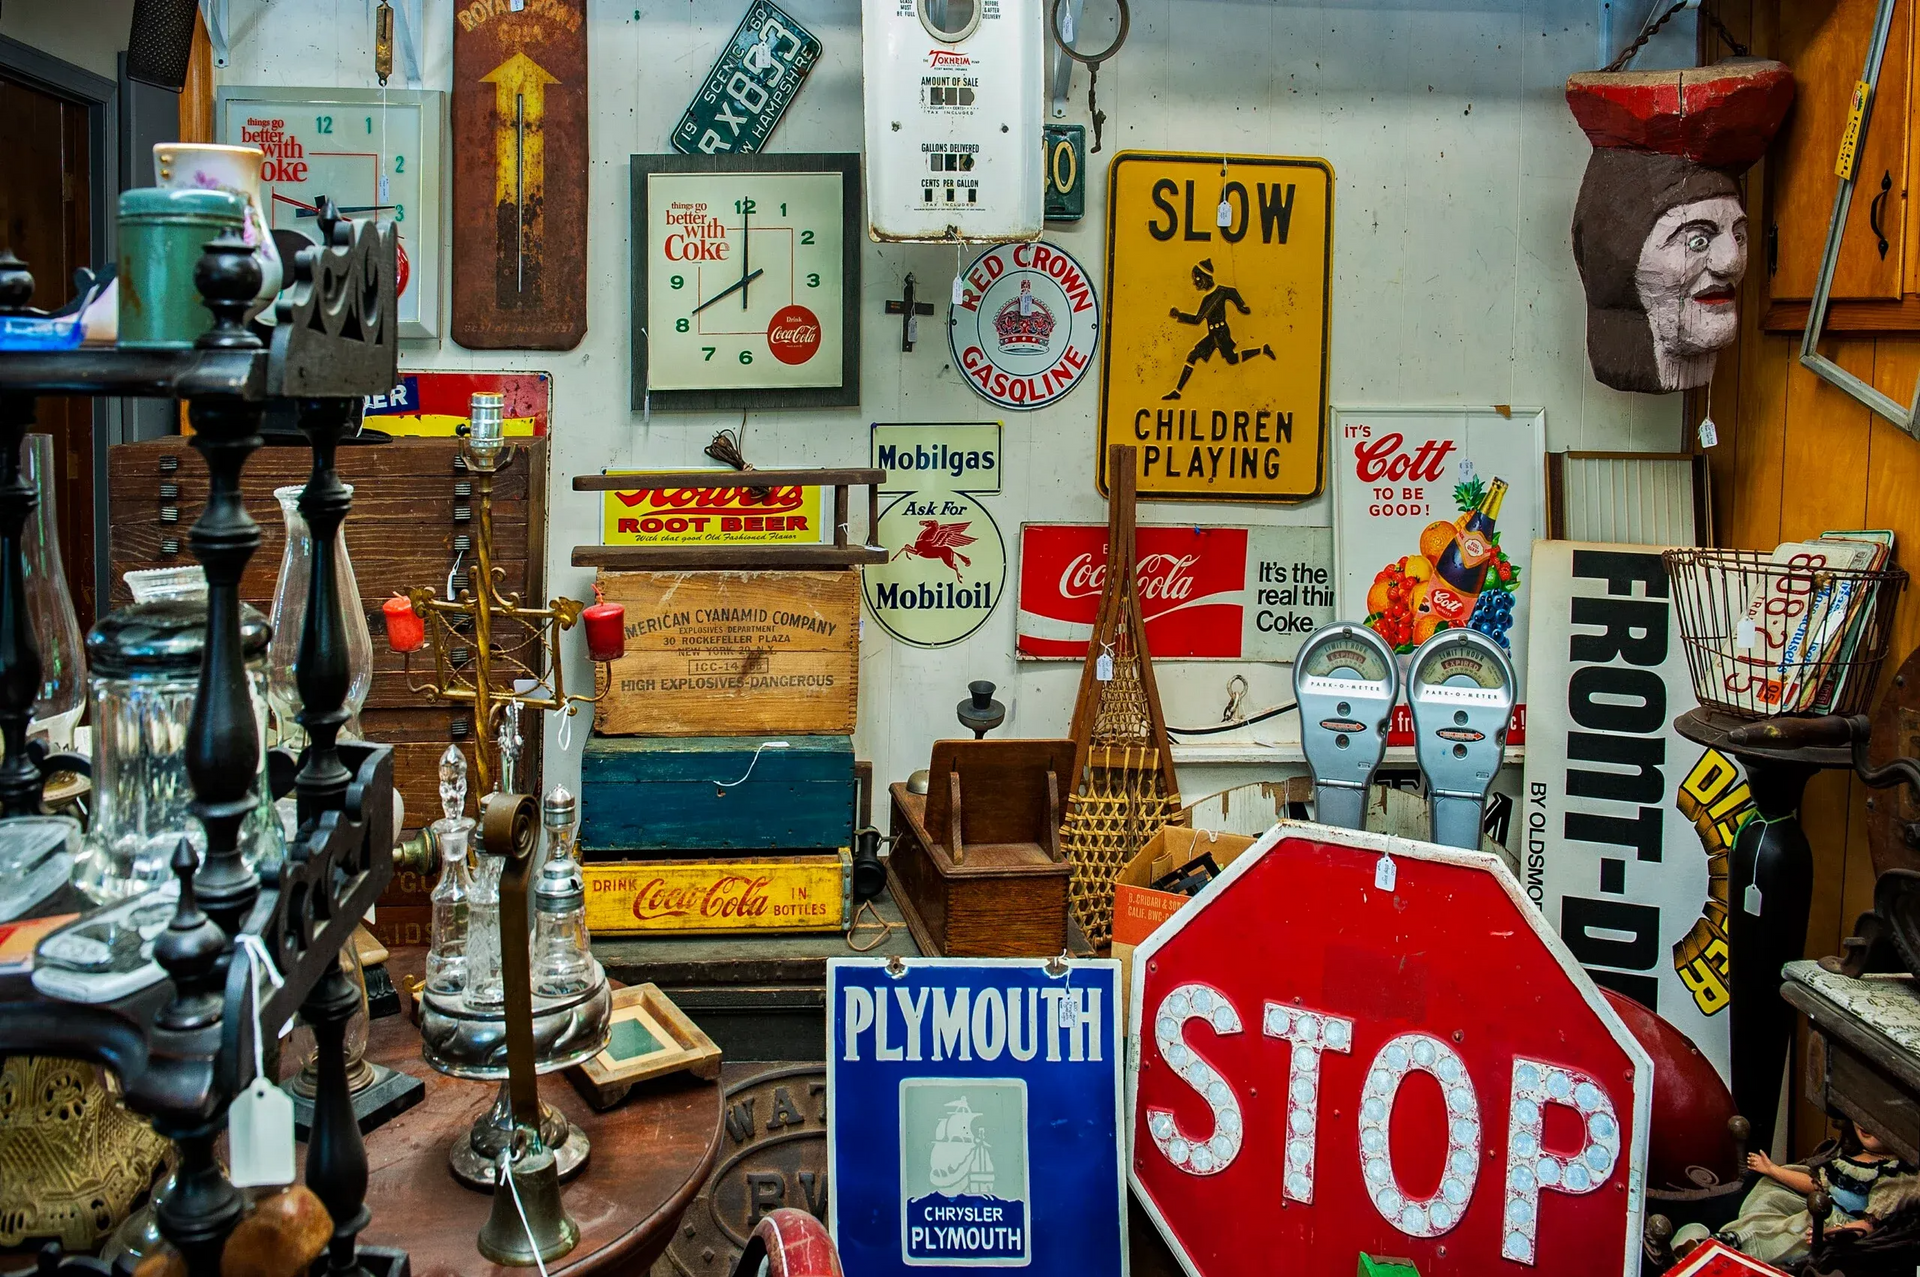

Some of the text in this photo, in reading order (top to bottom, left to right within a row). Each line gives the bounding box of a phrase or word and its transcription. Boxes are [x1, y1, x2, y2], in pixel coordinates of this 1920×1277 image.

[921, 77, 979, 87] AMOUNT OF SALE
[681, 122, 697, 141] 19
[704, 45, 745, 104] SCENIC
[752, 45, 813, 138] HAMPSHIRE
[247, 118, 284, 131] things go
[316, 116, 372, 134] 12 1
[242, 127, 284, 143] better
[259, 136, 303, 159] with
[921, 143, 980, 153] GALLONS DELIVERED
[261, 159, 308, 182] oke
[395, 156, 404, 173] 2
[921, 179, 979, 188] CENTS PER GALLON
[395, 204, 404, 222] 3
[671, 202, 707, 213] things go
[735, 200, 787, 217] 12 1
[1148, 178, 1296, 244] SLOW
[666, 210, 707, 226] better
[684, 218, 726, 239] with
[801, 230, 815, 245] 2
[664, 234, 730, 261] Coke
[670, 275, 684, 289] 9
[806, 273, 821, 288] 3
[959, 244, 1093, 314] RED CROWN
[676, 318, 690, 333] 8
[771, 325, 818, 344] Coca-Cola
[701, 347, 716, 361] 7
[739, 351, 753, 365] 6
[963, 345, 1087, 403] GASOLINE
[1134, 408, 1293, 443] CHILDREN
[878, 444, 995, 477] Mobilgas
[1143, 445, 1280, 480] PLAYING
[1354, 432, 1457, 483] Cott
[1373, 488, 1424, 500] TO BE
[902, 501, 967, 516] Ask For
[1369, 503, 1430, 517] GOOD!
[618, 516, 809, 533] ROOT BEER
[635, 534, 658, 542] With
[682, 534, 702, 543] good
[705, 533, 720, 541] Old
[723, 532, 767, 541] Fashioned
[769, 532, 797, 541] Flavor
[1258, 561, 1327, 584] It's the
[875, 581, 991, 610] Mobiloil
[1257, 585, 1298, 605] real
[1434, 590, 1463, 612] Cott
[623, 608, 837, 641] MERICAN CYANAMID COMPANY
[1256, 610, 1318, 632] Coke.
[679, 625, 776, 635] EXPLOSIVES DEPARTMENT
[663, 634, 791, 646] 30 ROCKEFELLER PLAZA
[678, 647, 701, 657] NEW
[706, 646, 734, 656] YORK
[1330, 652, 1363, 663] EXPIRED
[1439, 649, 1458, 660] LIMIT
[1466, 649, 1484, 662] HOUR
[1445, 660, 1479, 670] EXPIRED
[621, 679, 655, 692] HIGH
[1311, 682, 1380, 691] PARK-O-METER
[1426, 690, 1498, 699] PARK-O-METER
[1530, 782, 1547, 808] BY
[593, 876, 807, 920] DRINK Coca-Cola IN
[1162, 900, 1168, 910] &
[773, 904, 826, 917] BOTTLES
[1128, 905, 1147, 919] CALIF.
[843, 986, 1103, 1061] PLYMOUTH
[1147, 983, 1621, 1266] STOP
[924, 1207, 1003, 1222] CHRYSLER
[911, 1227, 1022, 1250] PLYMOUTH
